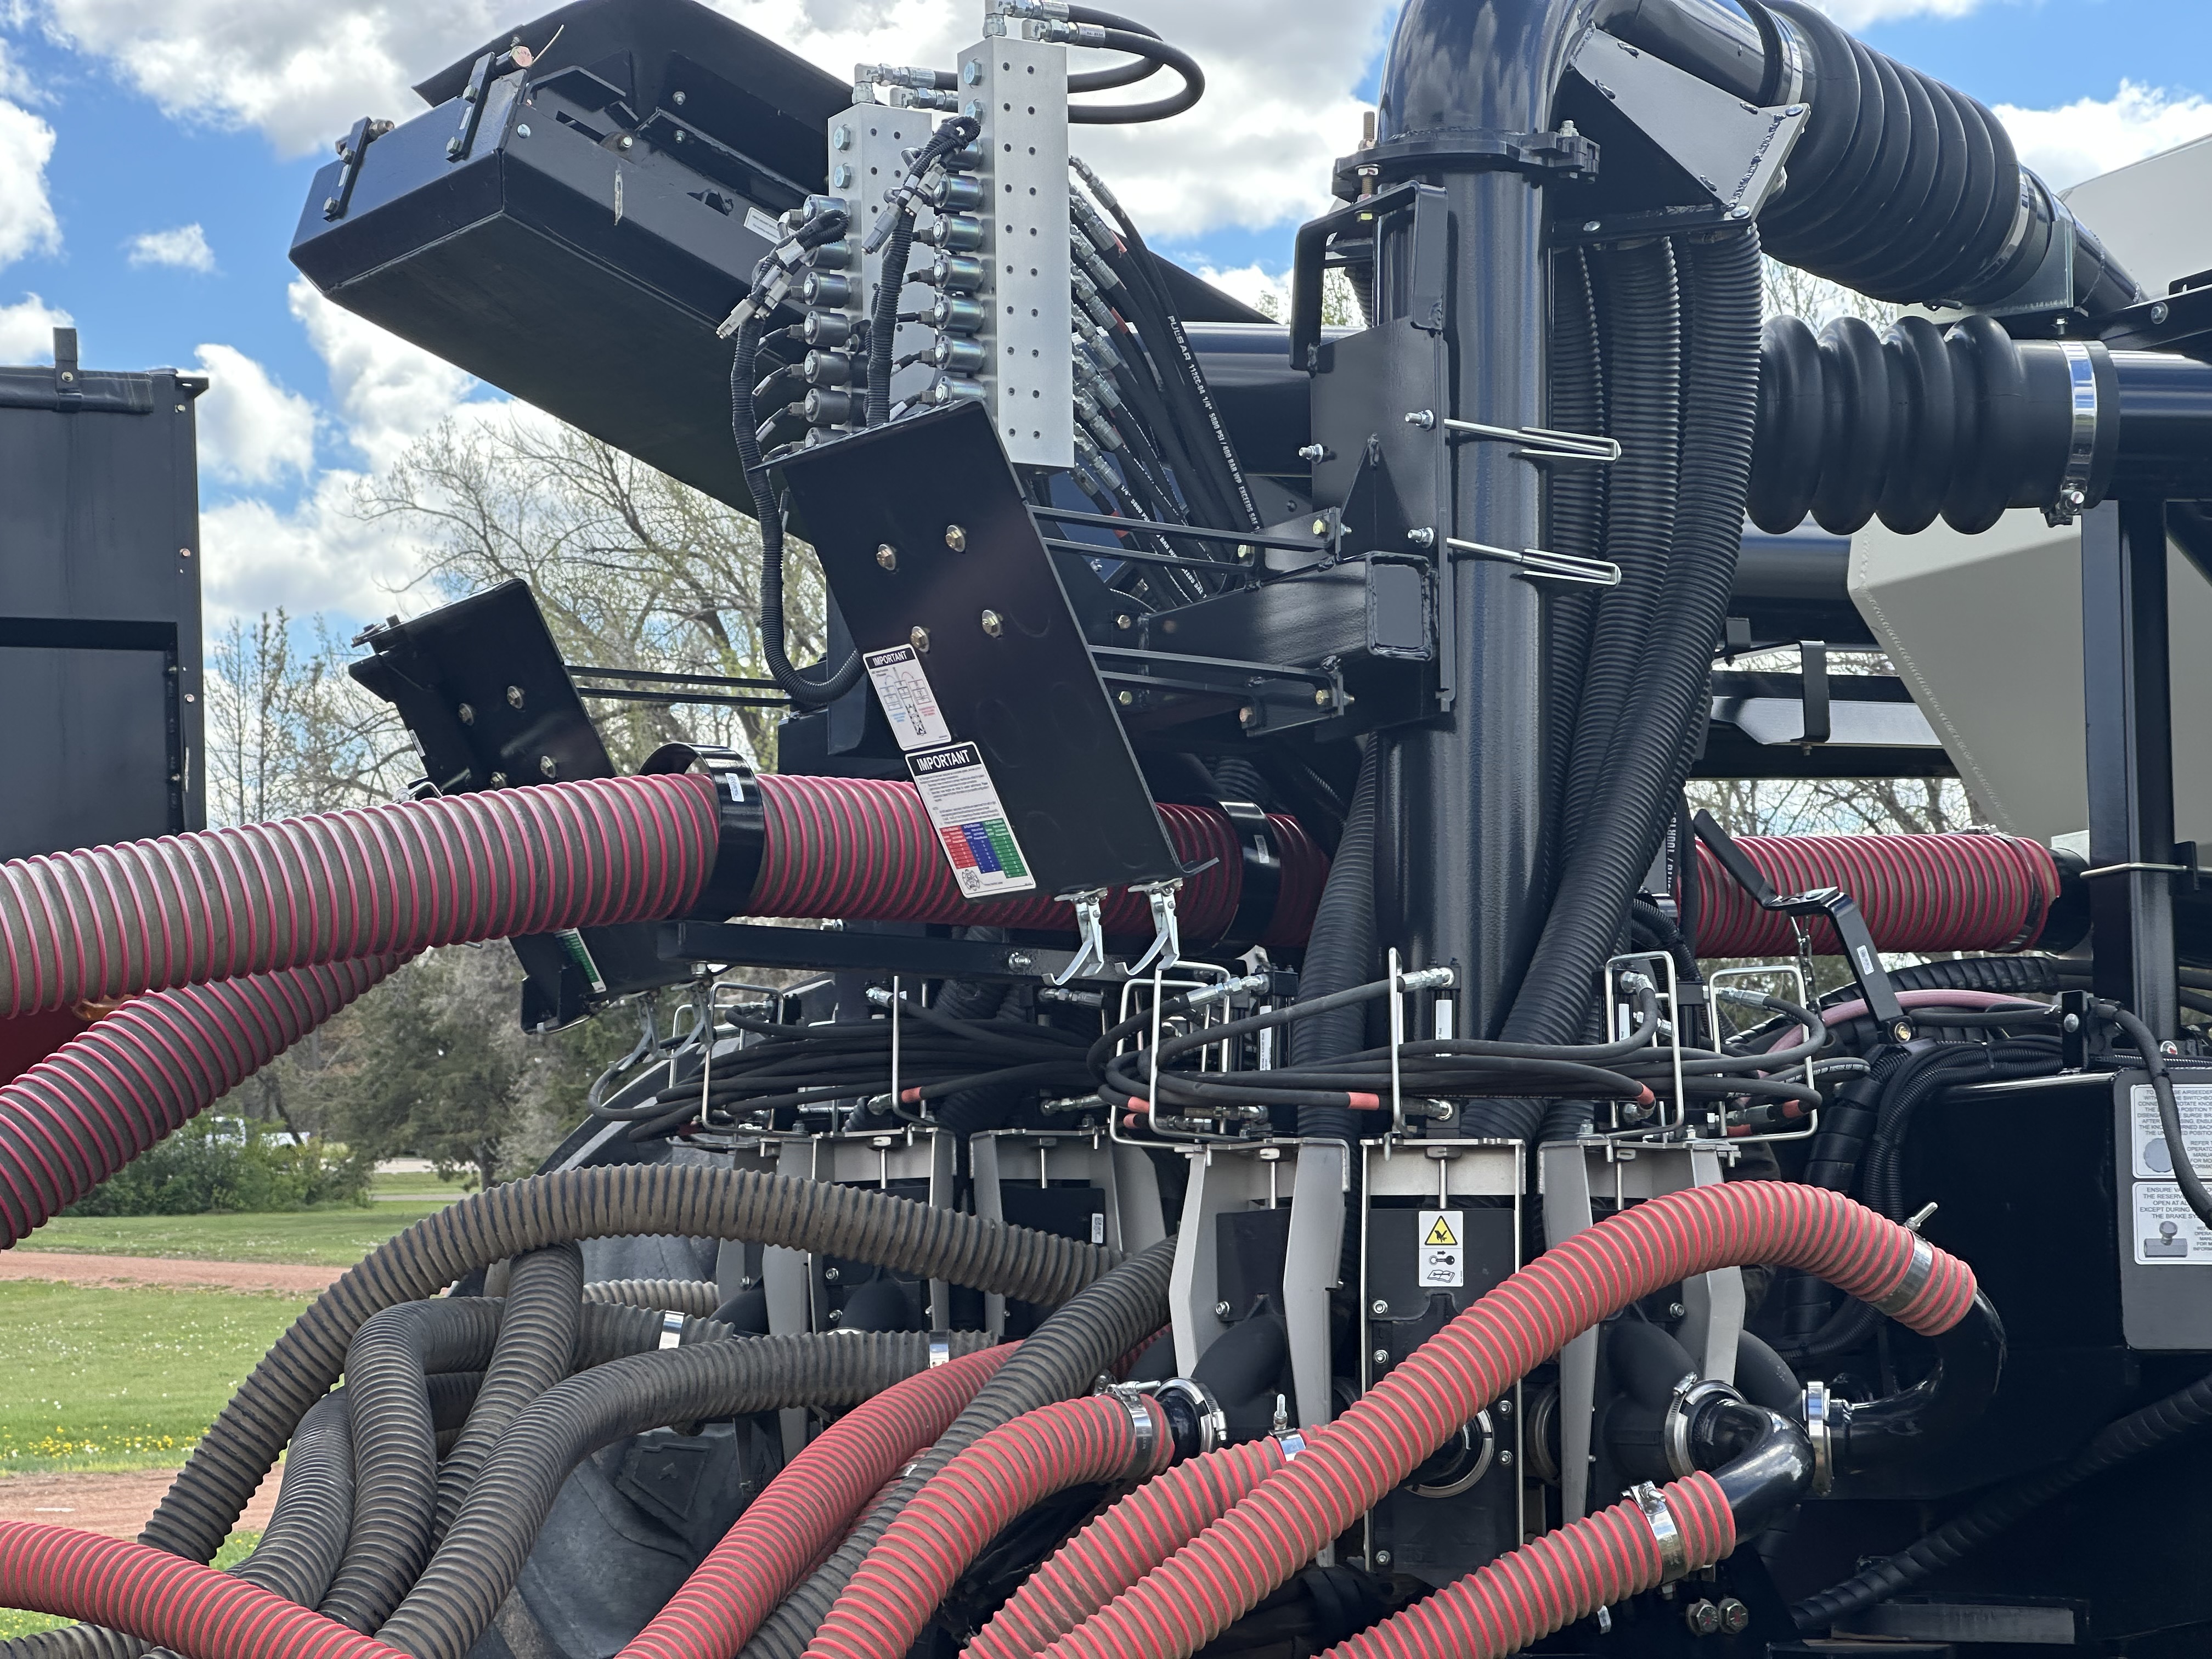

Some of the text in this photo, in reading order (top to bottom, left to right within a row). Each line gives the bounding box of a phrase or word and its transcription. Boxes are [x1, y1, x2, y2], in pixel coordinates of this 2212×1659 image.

[1167, 315, 1191, 360] PULSAR
[1216, 430, 1224, 441] PSI
[1223, 445, 1232, 458] 400
[1228, 459, 1237, 472] BAR
[1233, 472, 1242, 483] WP
[1238, 486, 1253, 512] EXCEEDS
[1249, 512, 1258, 525] SAE
[872, 651, 907, 666] IMPORTANT
[916, 749, 970, 771] IMPORTANT
